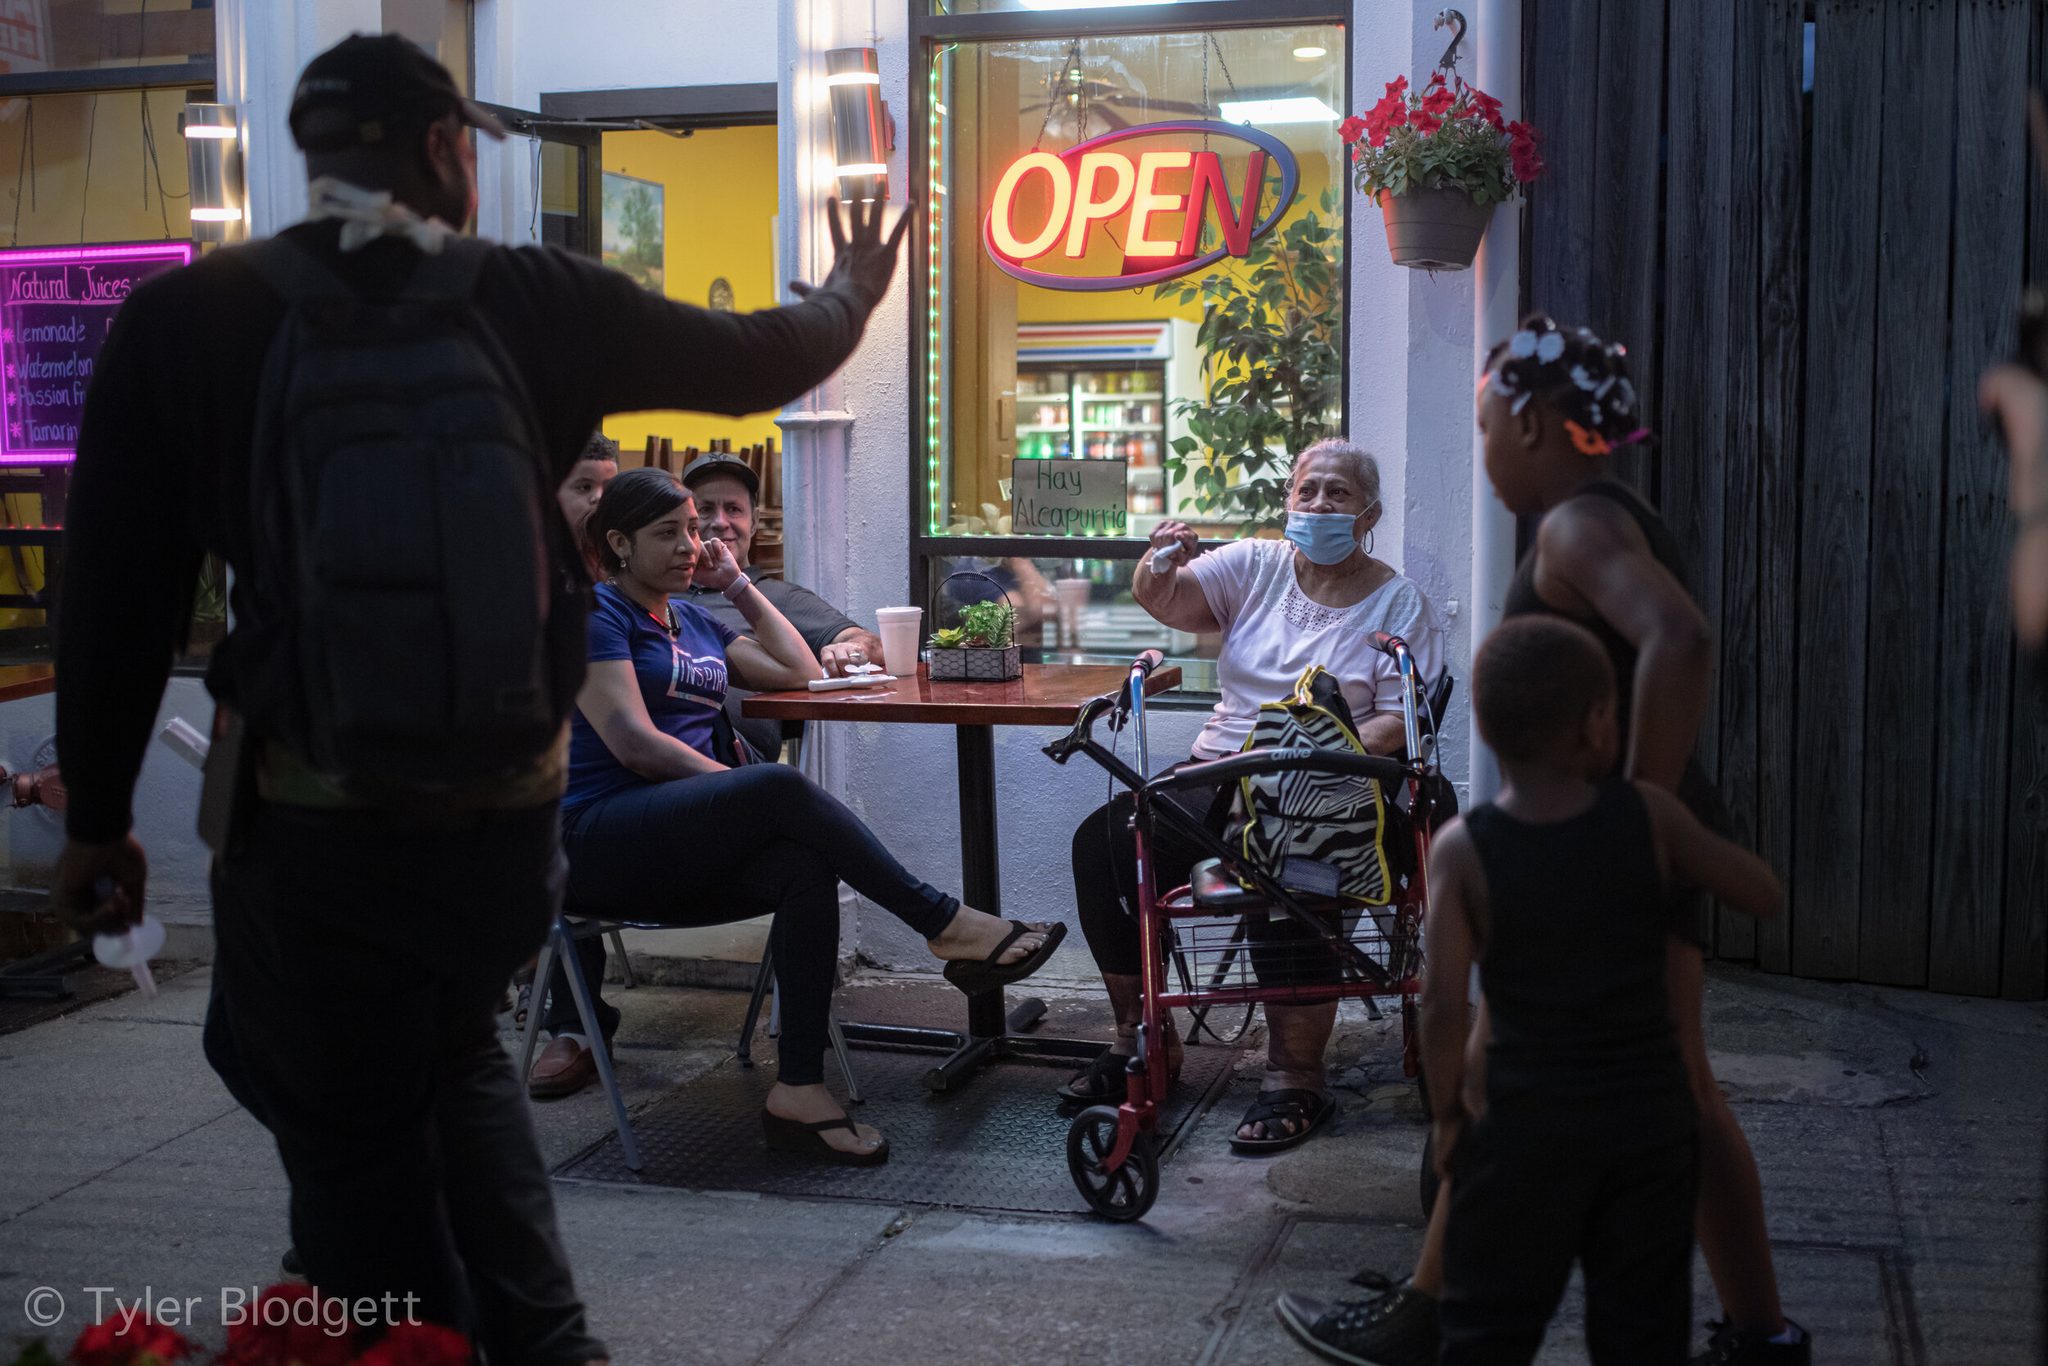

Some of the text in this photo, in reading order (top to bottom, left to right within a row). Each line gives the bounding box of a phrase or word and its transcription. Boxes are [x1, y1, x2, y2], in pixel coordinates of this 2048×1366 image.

[990, 151, 1266, 259] OPEN
[10, 265, 132, 301] Natural Juices
[16, 316, 86, 343] Lemonade
[17, 351, 93, 379] Watermelon
[19, 384, 71, 407] Passion
[25, 419, 79, 441] Tamarin
[1037, 460, 1082, 496] Hay
[1015, 497, 1127, 533] Alcapurria
[1271, 748, 1312, 761] drive
